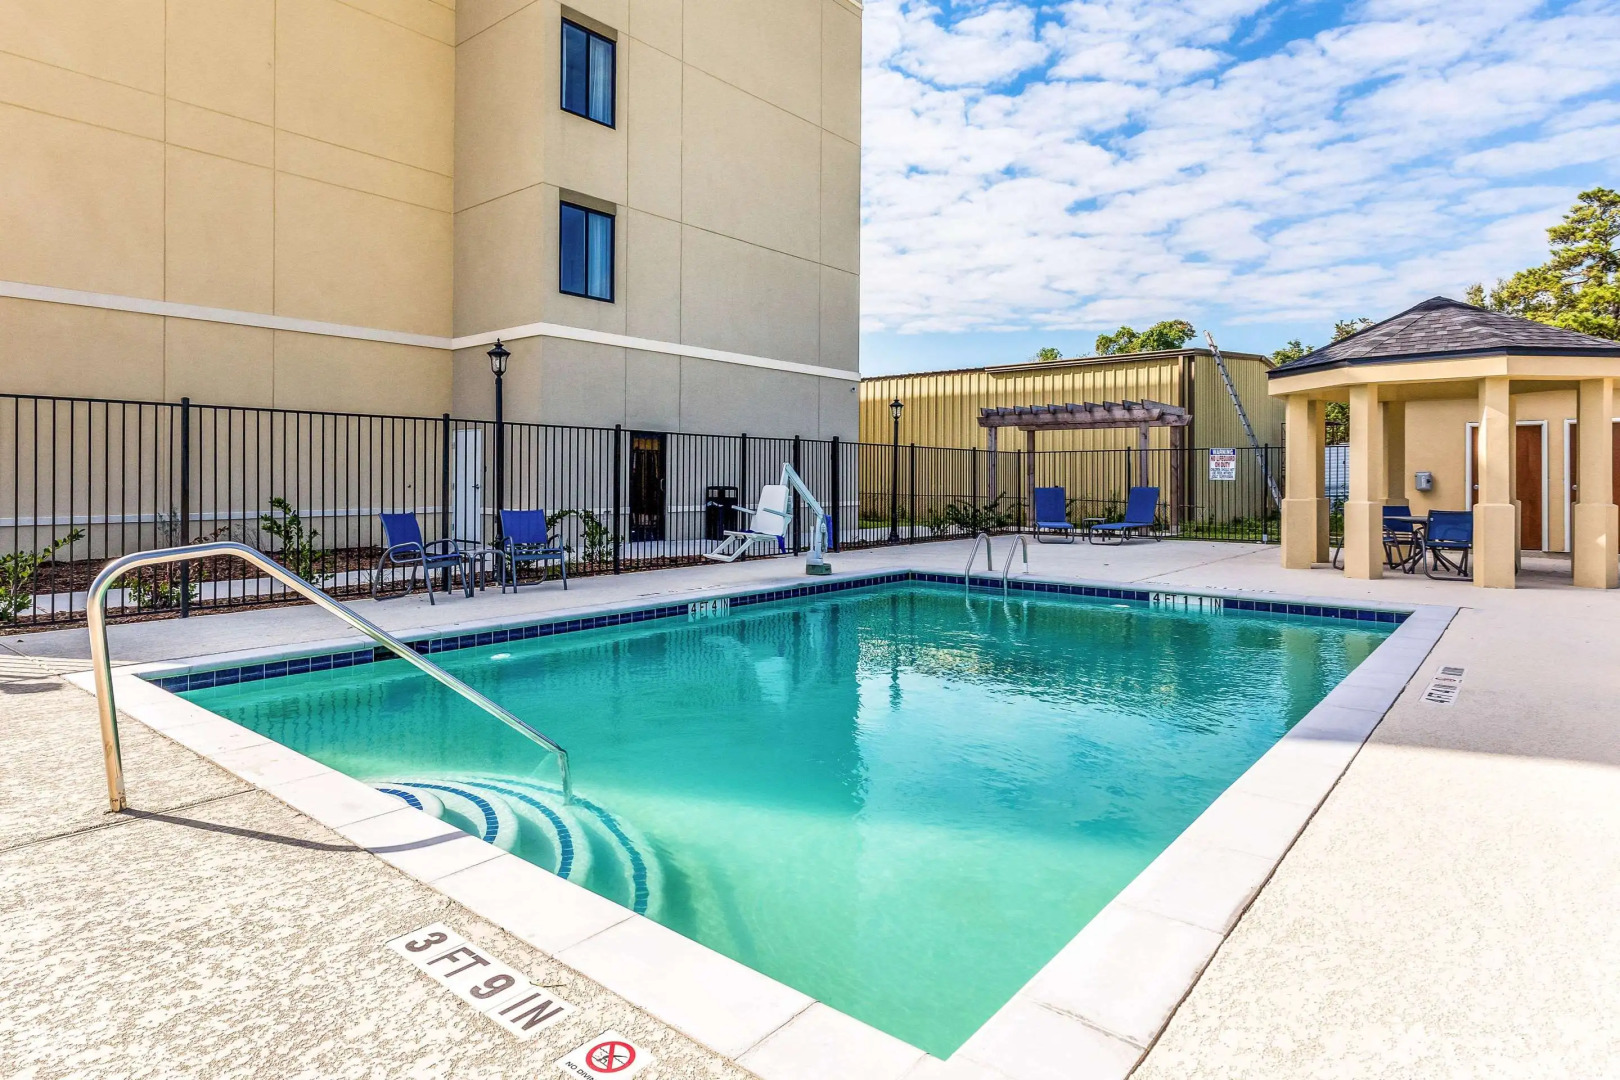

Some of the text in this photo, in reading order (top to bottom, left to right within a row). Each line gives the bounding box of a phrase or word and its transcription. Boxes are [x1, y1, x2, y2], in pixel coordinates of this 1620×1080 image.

[1165, 594, 1177, 603] FT
[405, 932, 565, 1031] 3 FT 9 IN
[565, 1061, 577, 1070] NO
